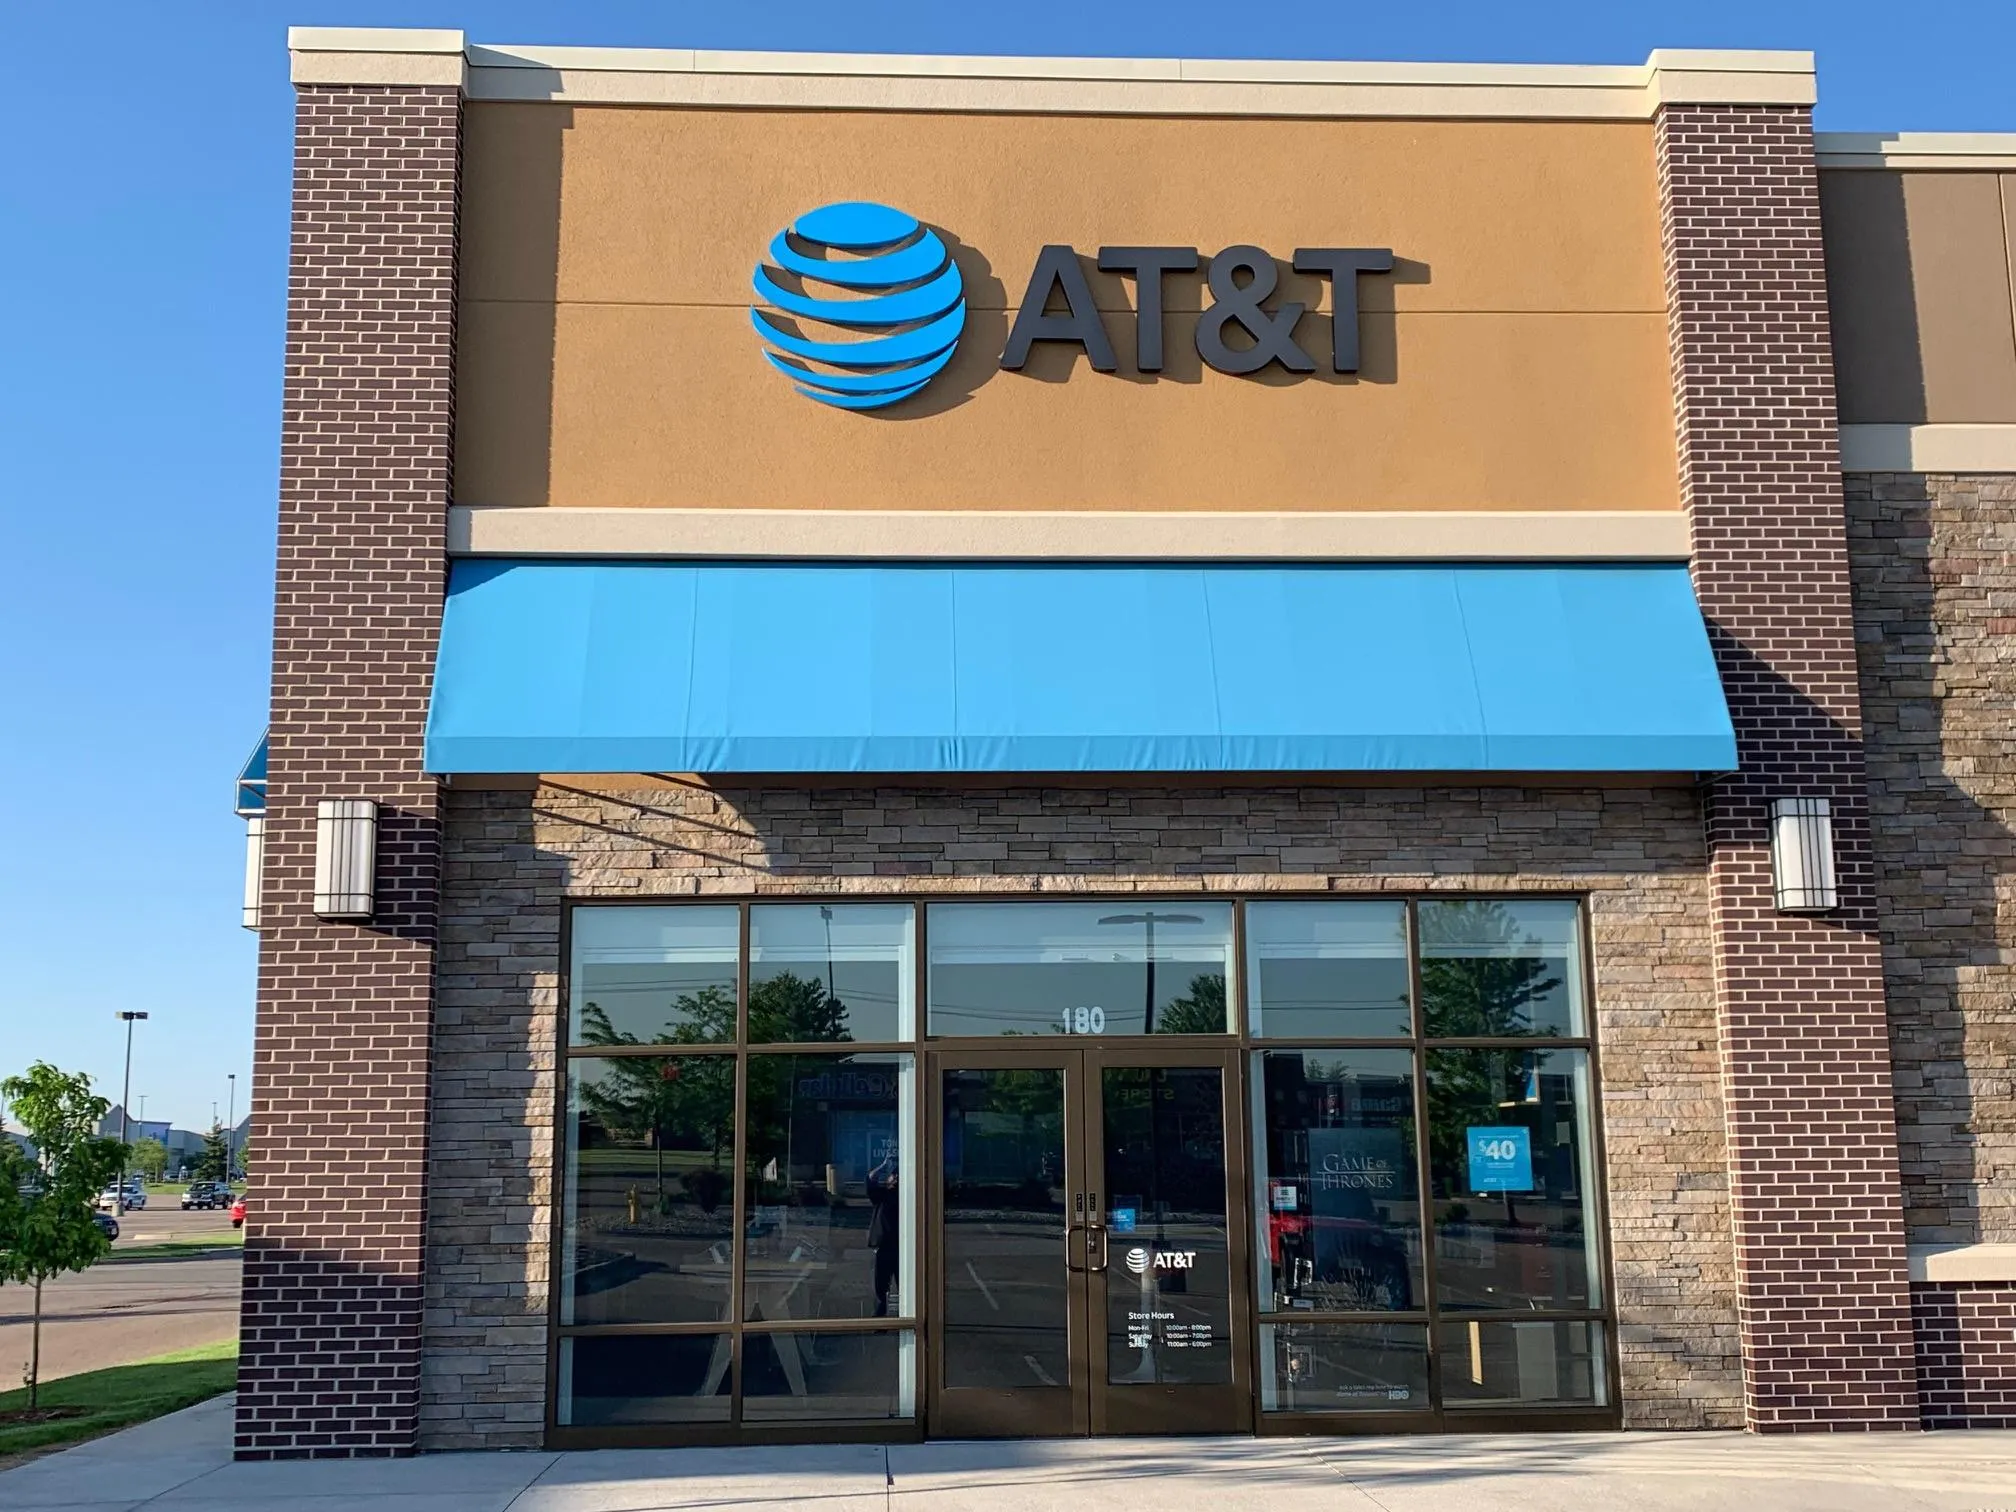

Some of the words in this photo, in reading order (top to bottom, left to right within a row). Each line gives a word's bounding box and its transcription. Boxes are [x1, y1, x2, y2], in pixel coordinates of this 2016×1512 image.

[1000, 245, 1393, 374] AT&T
[1062, 1006, 1105, 1034] 180
[1478, 1139, 1516, 1160] $40
[1323, 1153, 1374, 1172] GAME
[1321, 1173, 1393, 1190] THRONES
[1152, 1252, 1196, 1268] AT&T
[1388, 1390, 1409, 1400] HBO
